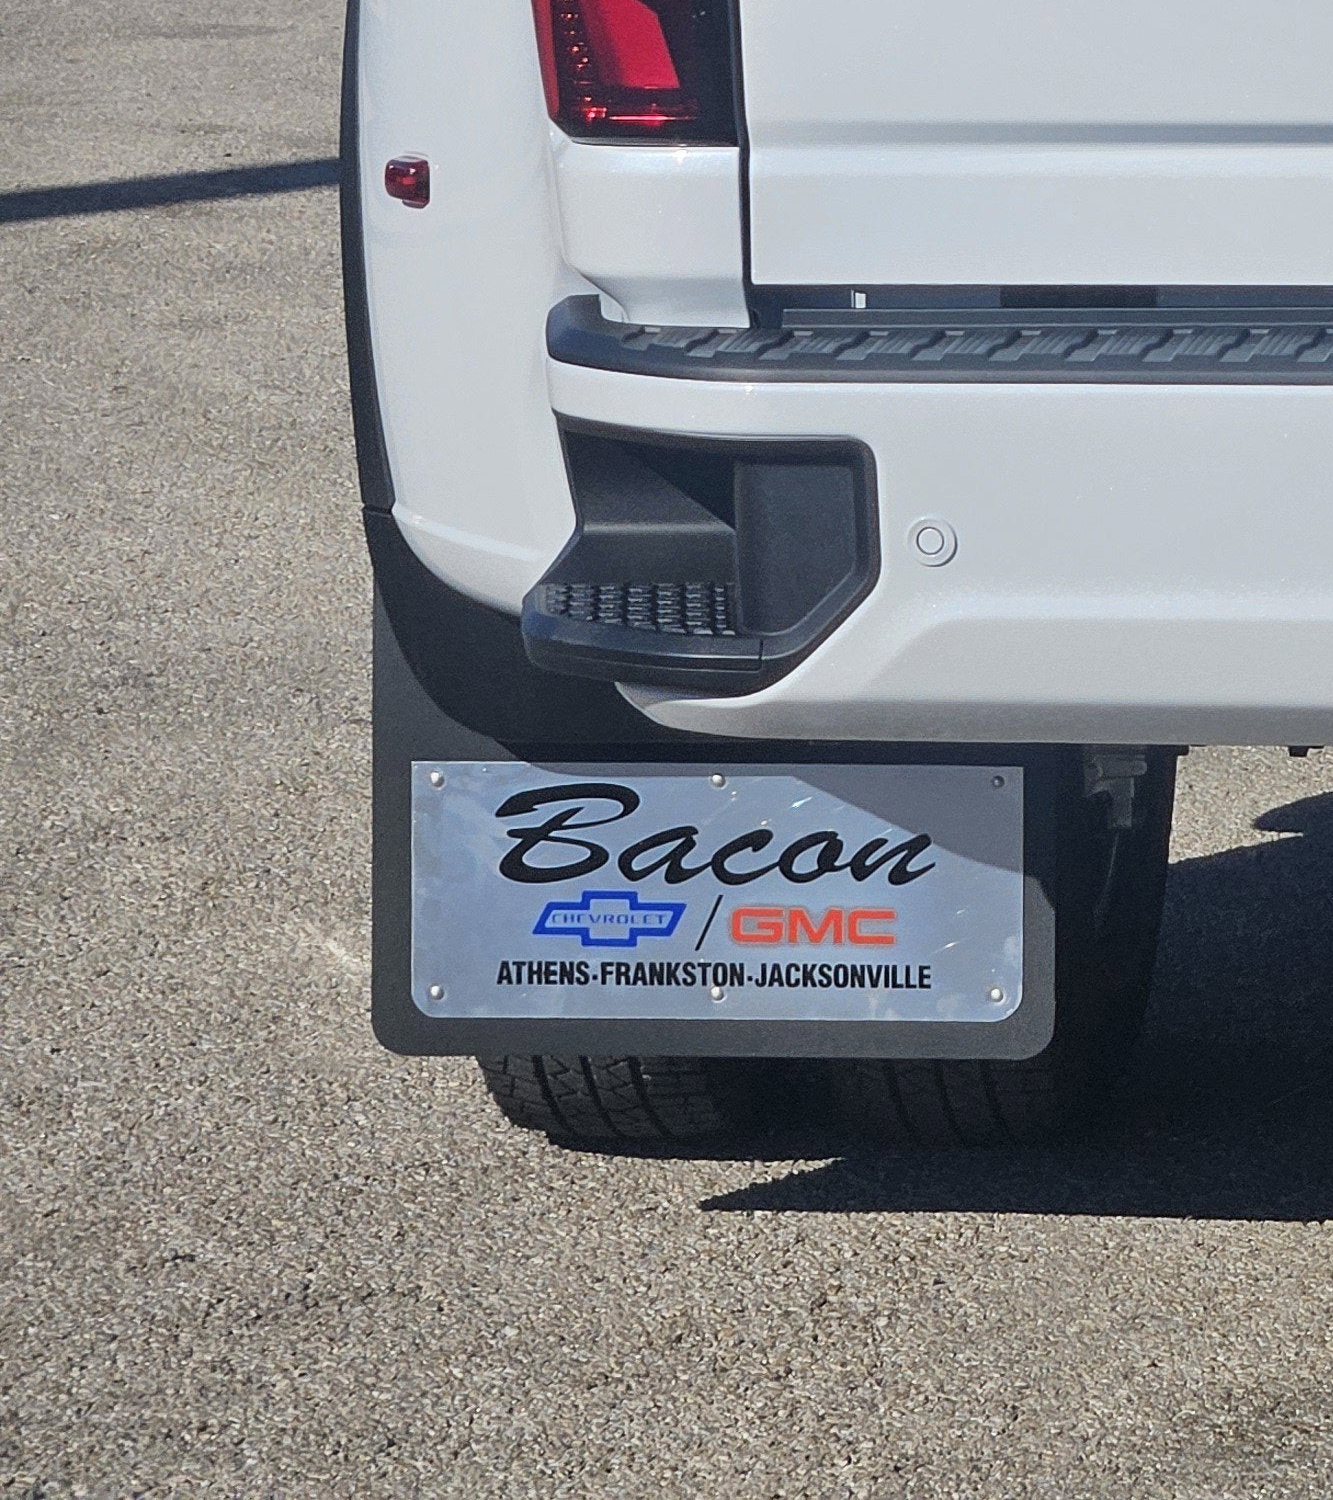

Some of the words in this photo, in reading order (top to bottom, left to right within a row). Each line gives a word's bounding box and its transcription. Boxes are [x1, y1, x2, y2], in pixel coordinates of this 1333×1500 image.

[495, 782, 936, 885] Bacon
[551, 913, 668, 925] CHEVROLET
[731, 907, 897, 946] GMC
